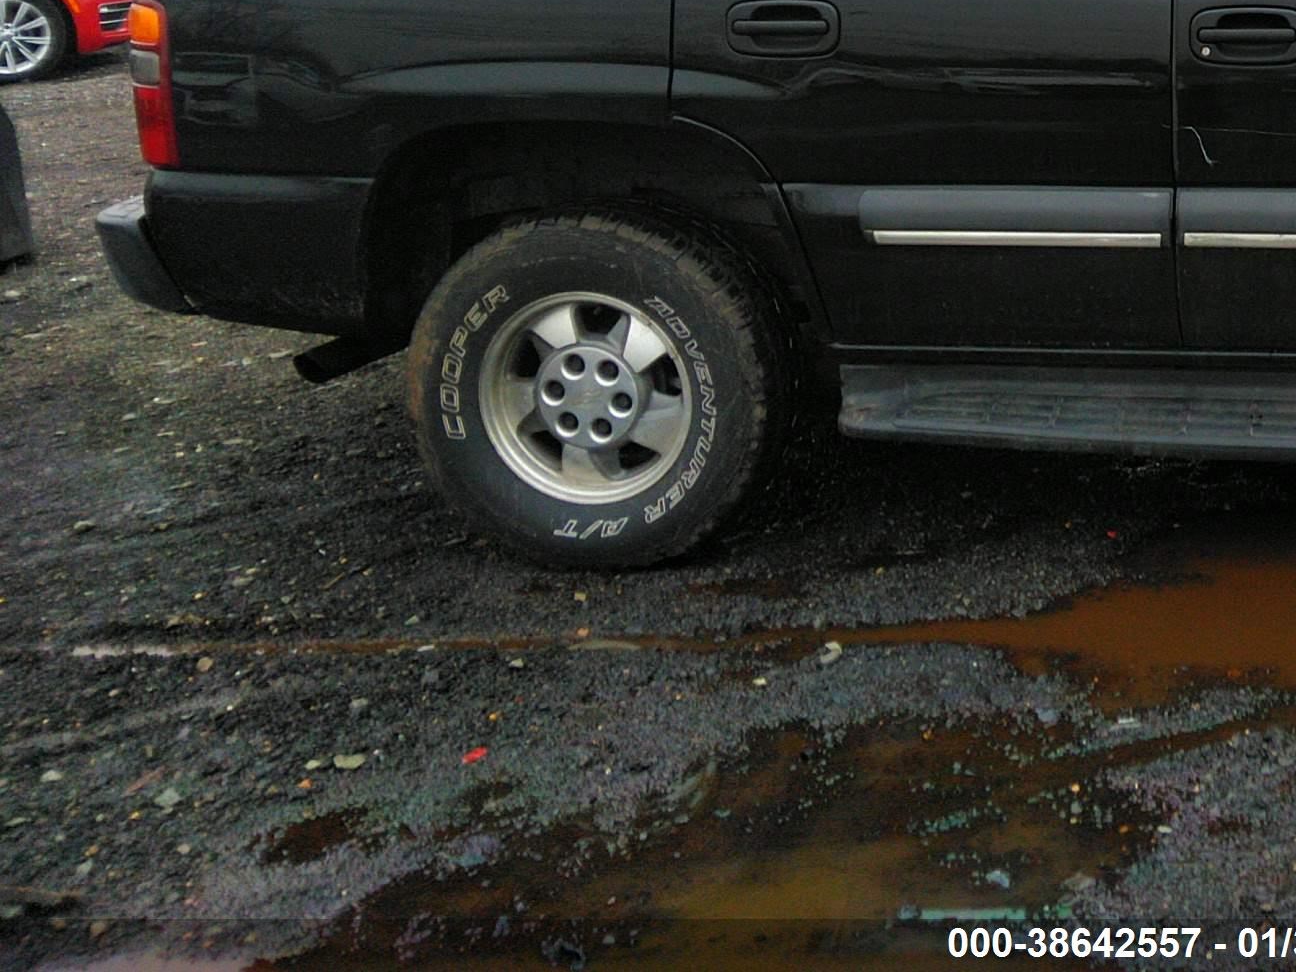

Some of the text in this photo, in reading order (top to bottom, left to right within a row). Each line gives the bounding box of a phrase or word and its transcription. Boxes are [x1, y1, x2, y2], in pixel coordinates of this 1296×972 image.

[437, 284, 511, 441] COOPER
[554, 295, 718, 541] ADVENTURER A/T
